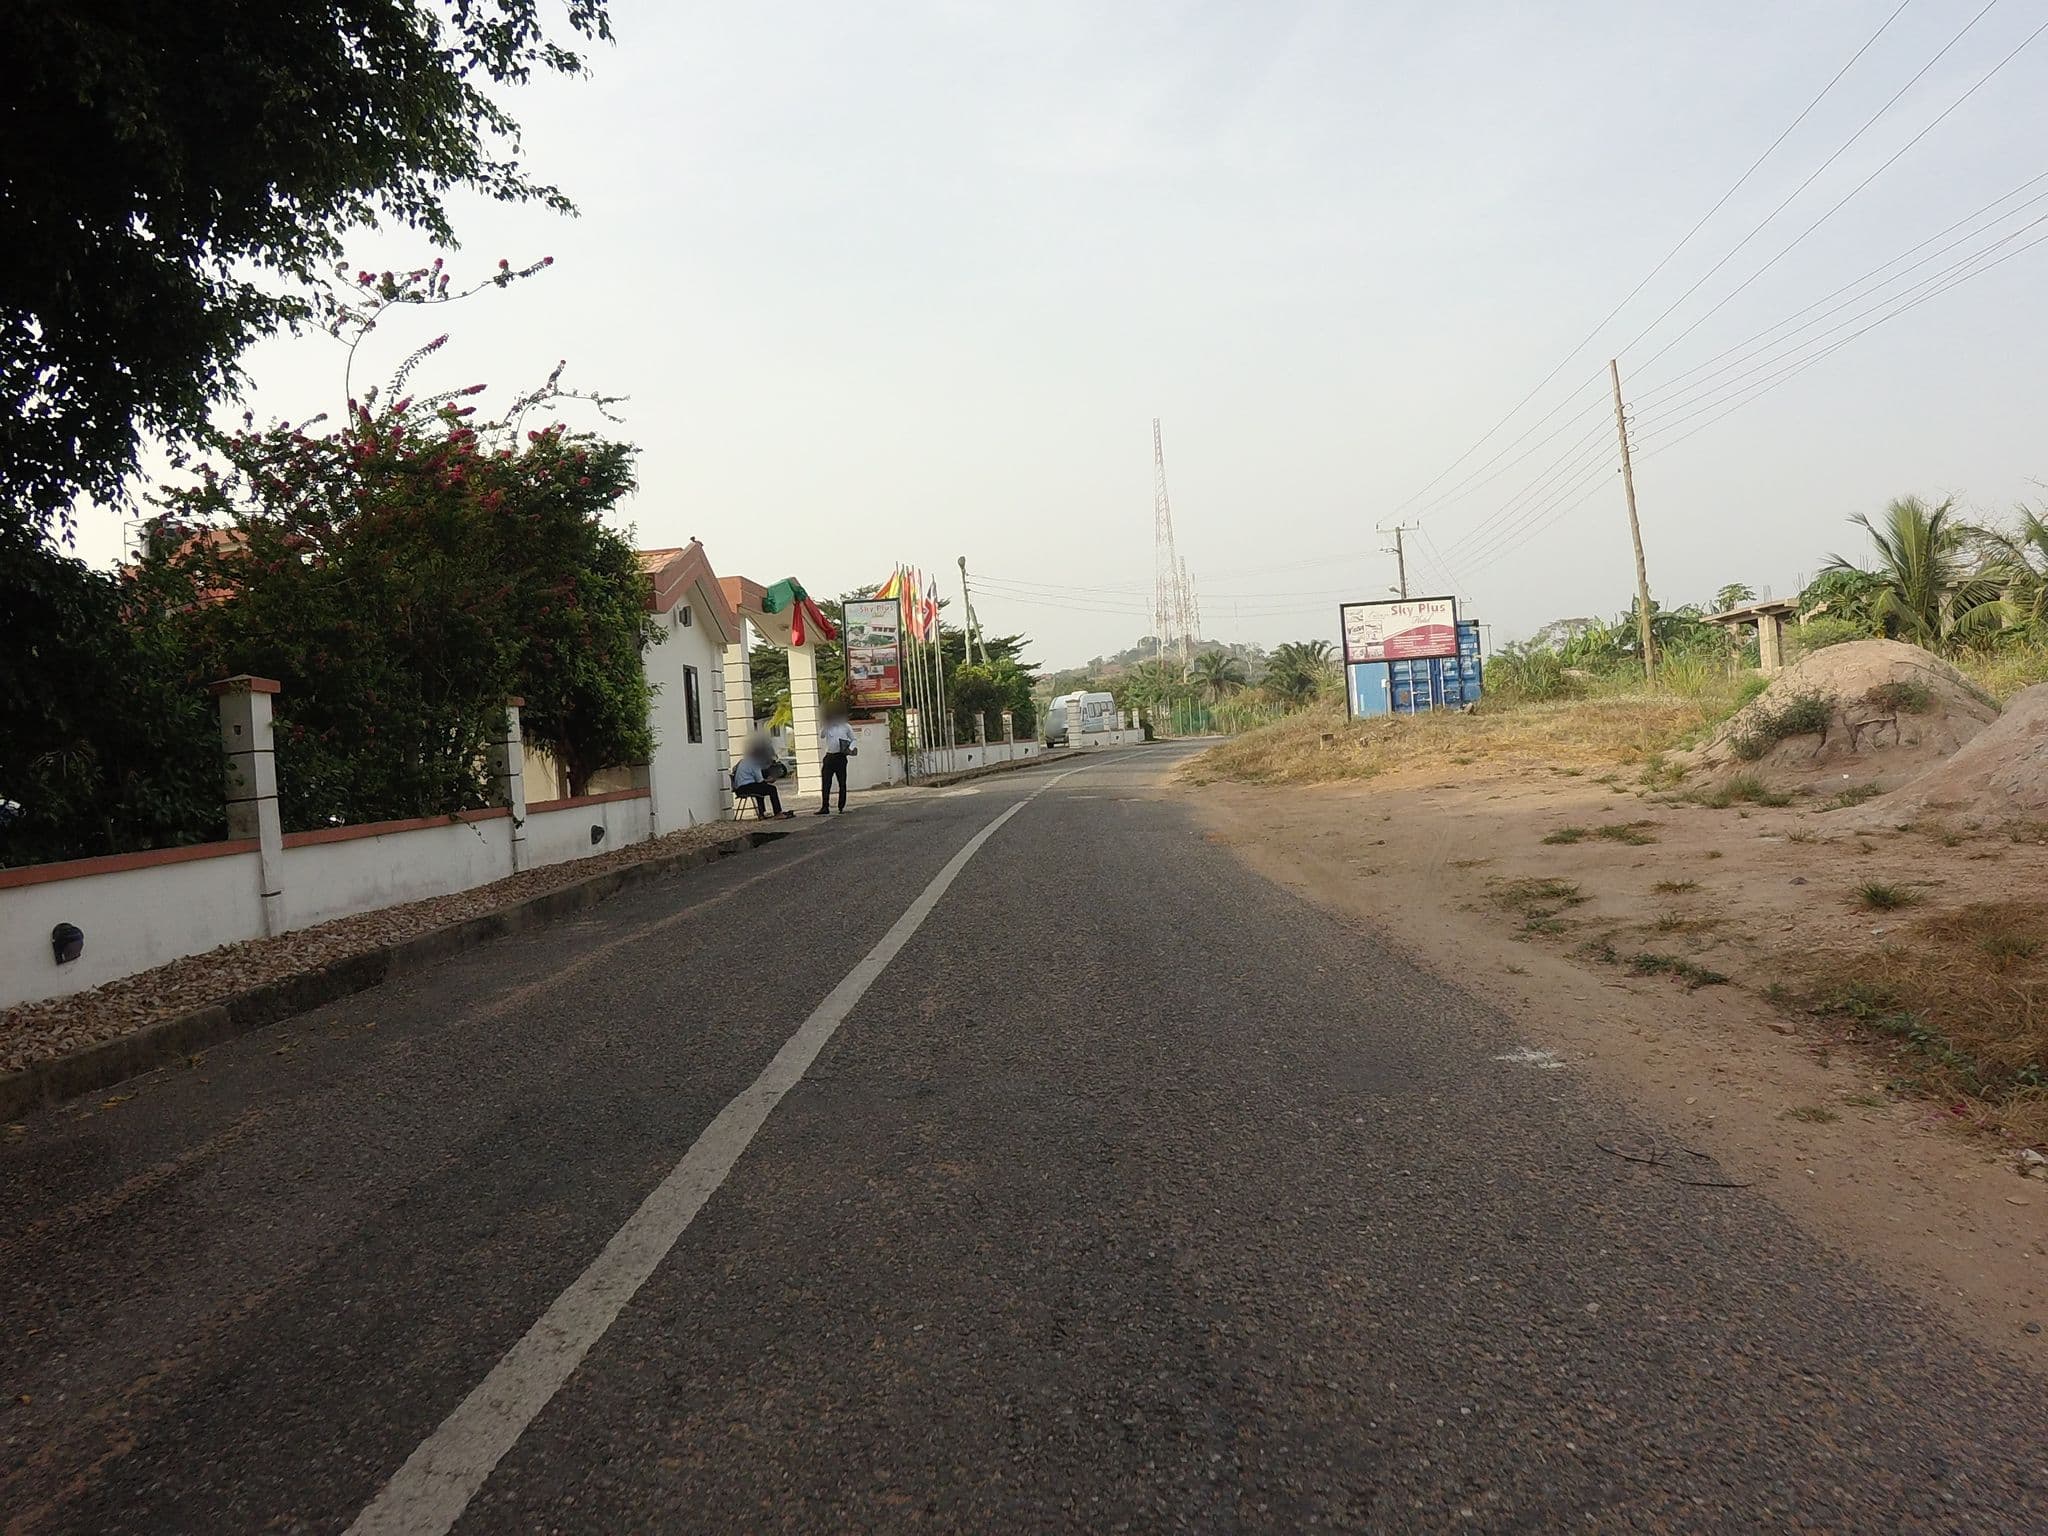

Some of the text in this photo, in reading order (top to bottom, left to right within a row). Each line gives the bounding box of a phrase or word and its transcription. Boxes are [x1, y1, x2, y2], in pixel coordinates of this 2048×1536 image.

[876, 604, 894, 612] Plus
[1390, 605, 1413, 617] Sky
[1418, 603, 1446, 613] Plus
